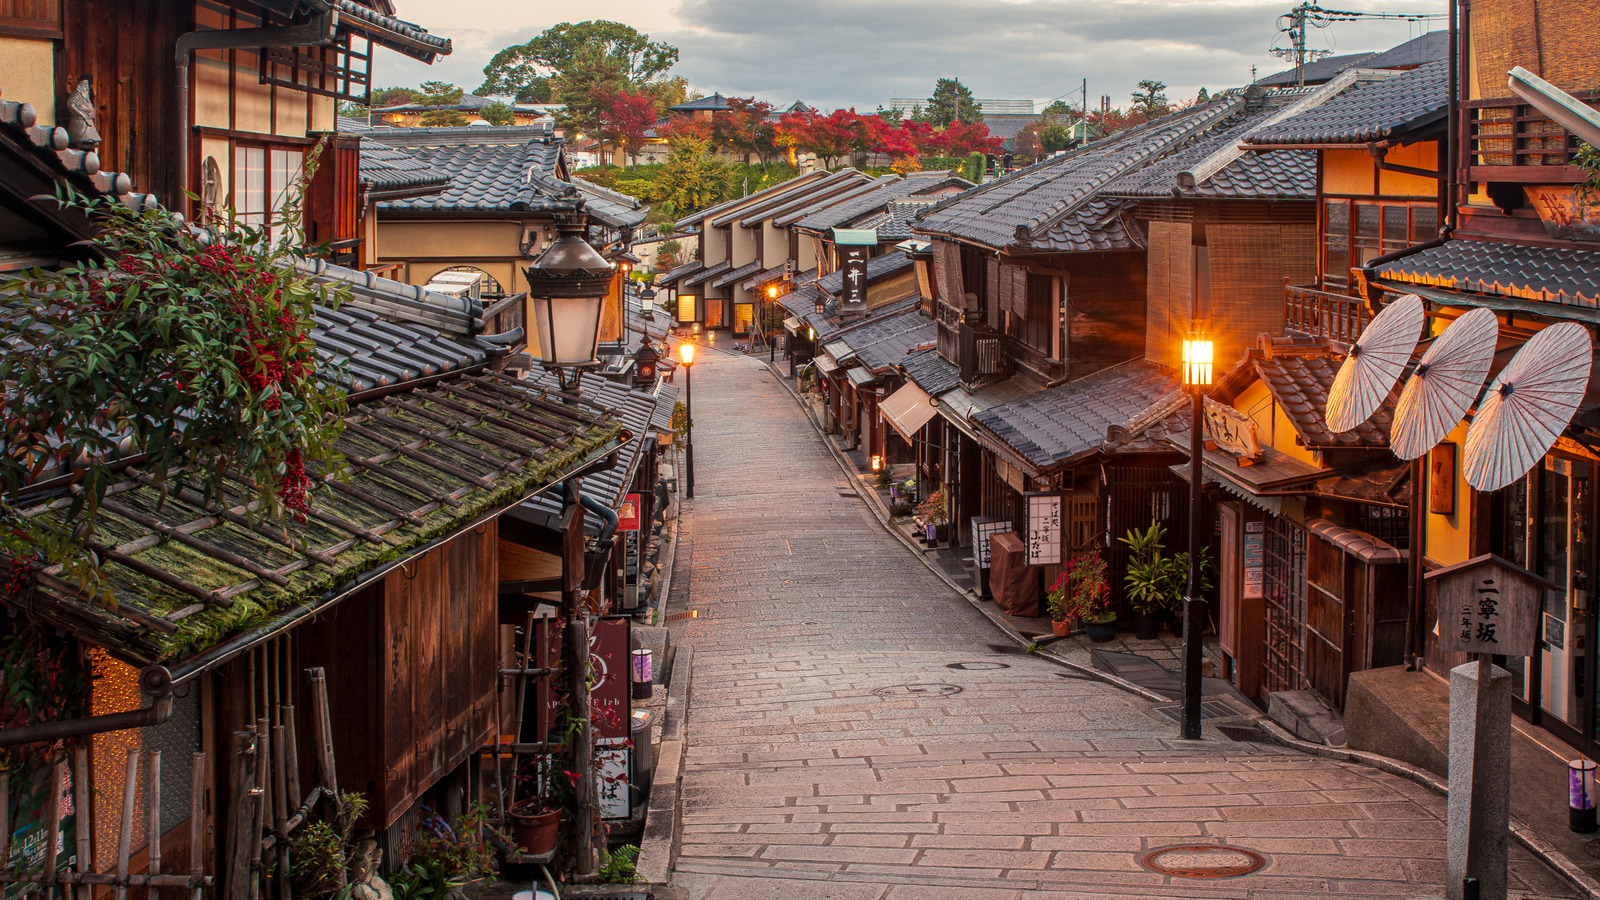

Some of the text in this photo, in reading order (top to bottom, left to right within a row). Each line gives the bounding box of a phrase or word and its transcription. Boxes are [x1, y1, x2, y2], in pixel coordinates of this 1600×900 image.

[847, 251, 864, 303] 二井三
[1051, 502, 1059, 527] そば処
[1031, 531, 1042, 558] ふたば
[1476, 579, 1499, 643] 二寧坂
